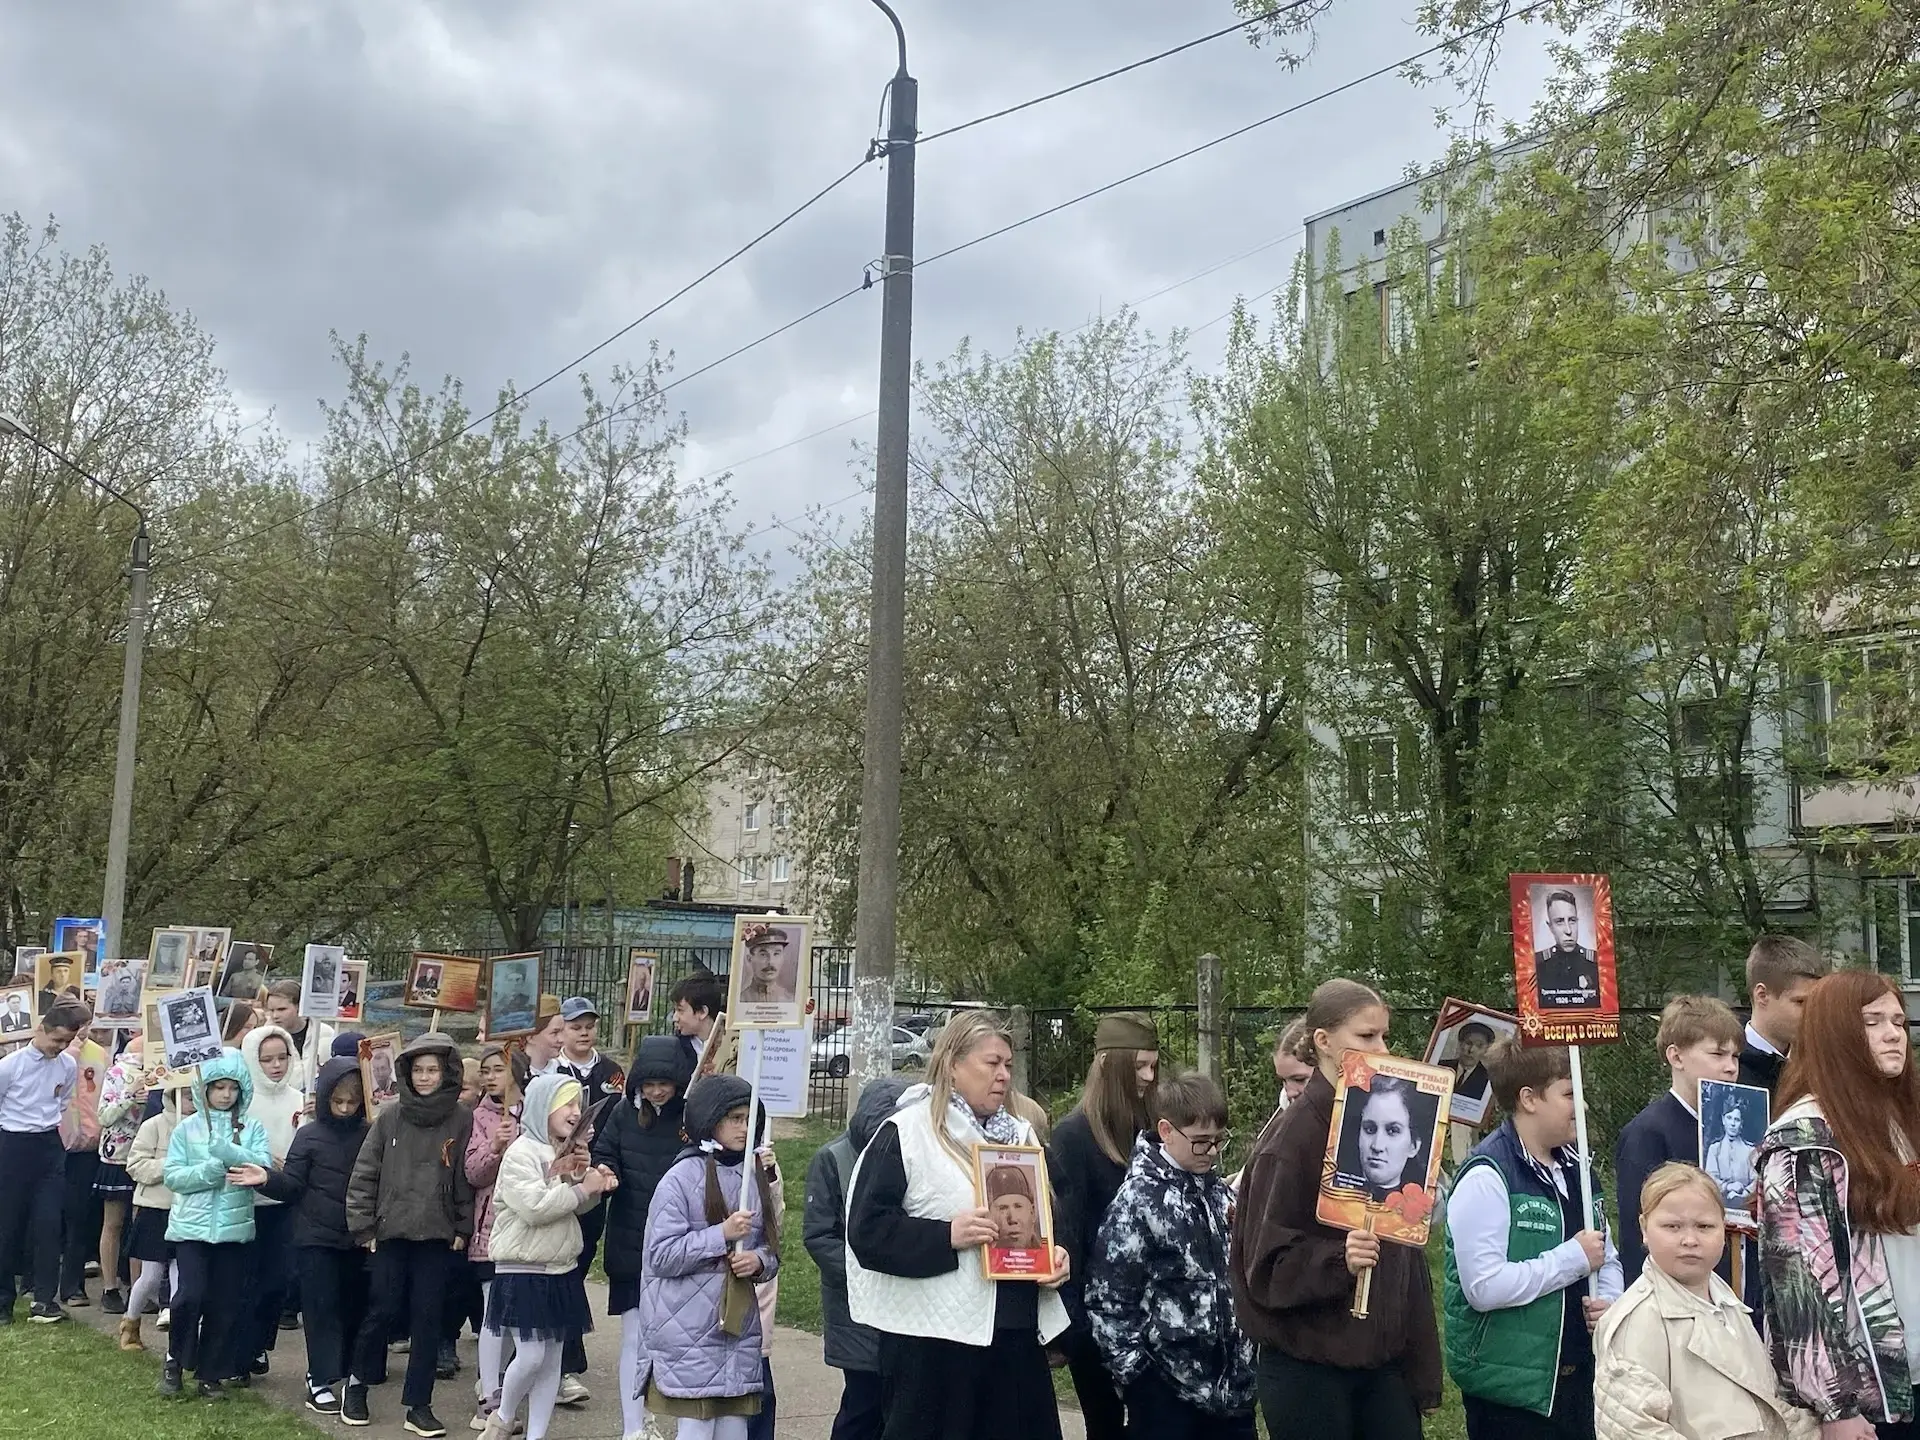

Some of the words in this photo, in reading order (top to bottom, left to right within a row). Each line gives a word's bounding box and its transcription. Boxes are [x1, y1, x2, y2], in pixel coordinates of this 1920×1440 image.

[1544, 1025, 1578, 1042] ВСЕГДА
[1579, 1025, 1585, 1038] В
[1587, 1024, 1618, 1038] СТРОЮ!
[1379, 1064, 1449, 1084] БЕССМЕРТНЫЙ
[1422, 1082, 1448, 1093] ПОЛК
